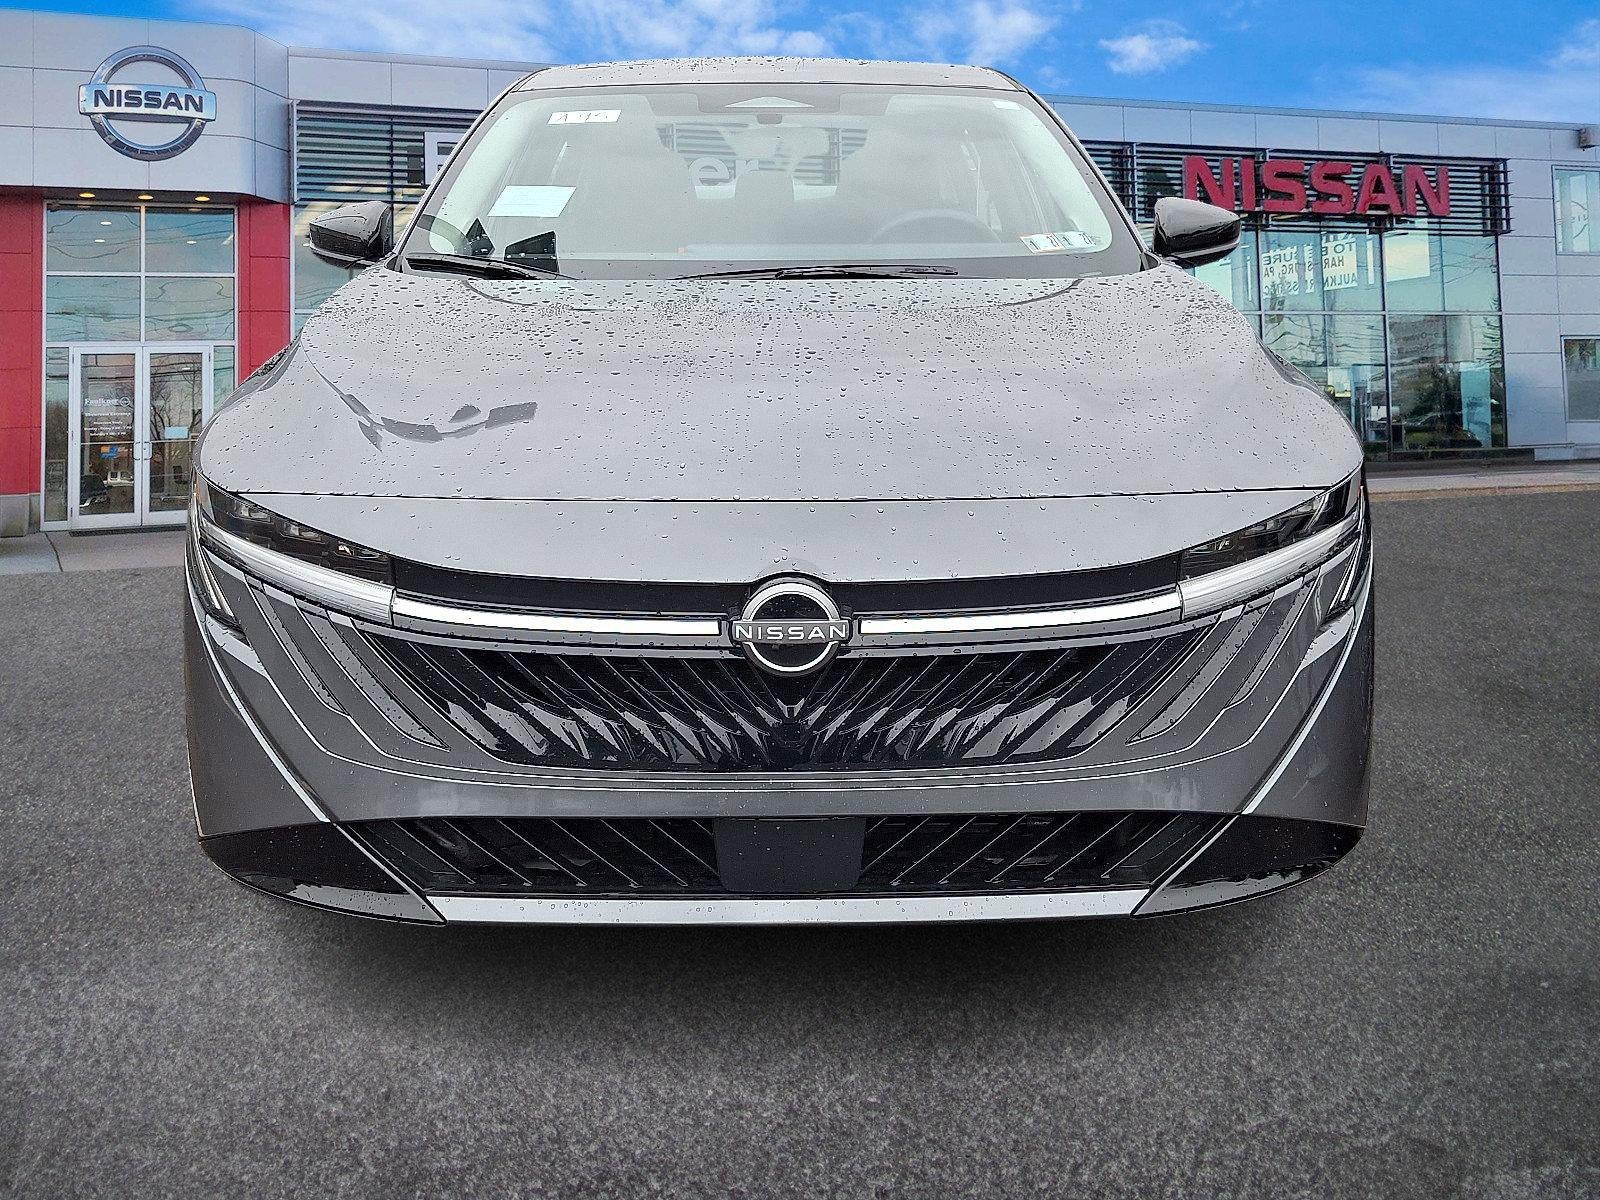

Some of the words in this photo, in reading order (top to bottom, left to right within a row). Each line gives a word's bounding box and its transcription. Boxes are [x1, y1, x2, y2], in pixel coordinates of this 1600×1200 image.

[94, 89, 203, 113] NISSAN
[1183, 155, 1451, 217] NISSAN
[735, 624, 846, 640] NISSAN
